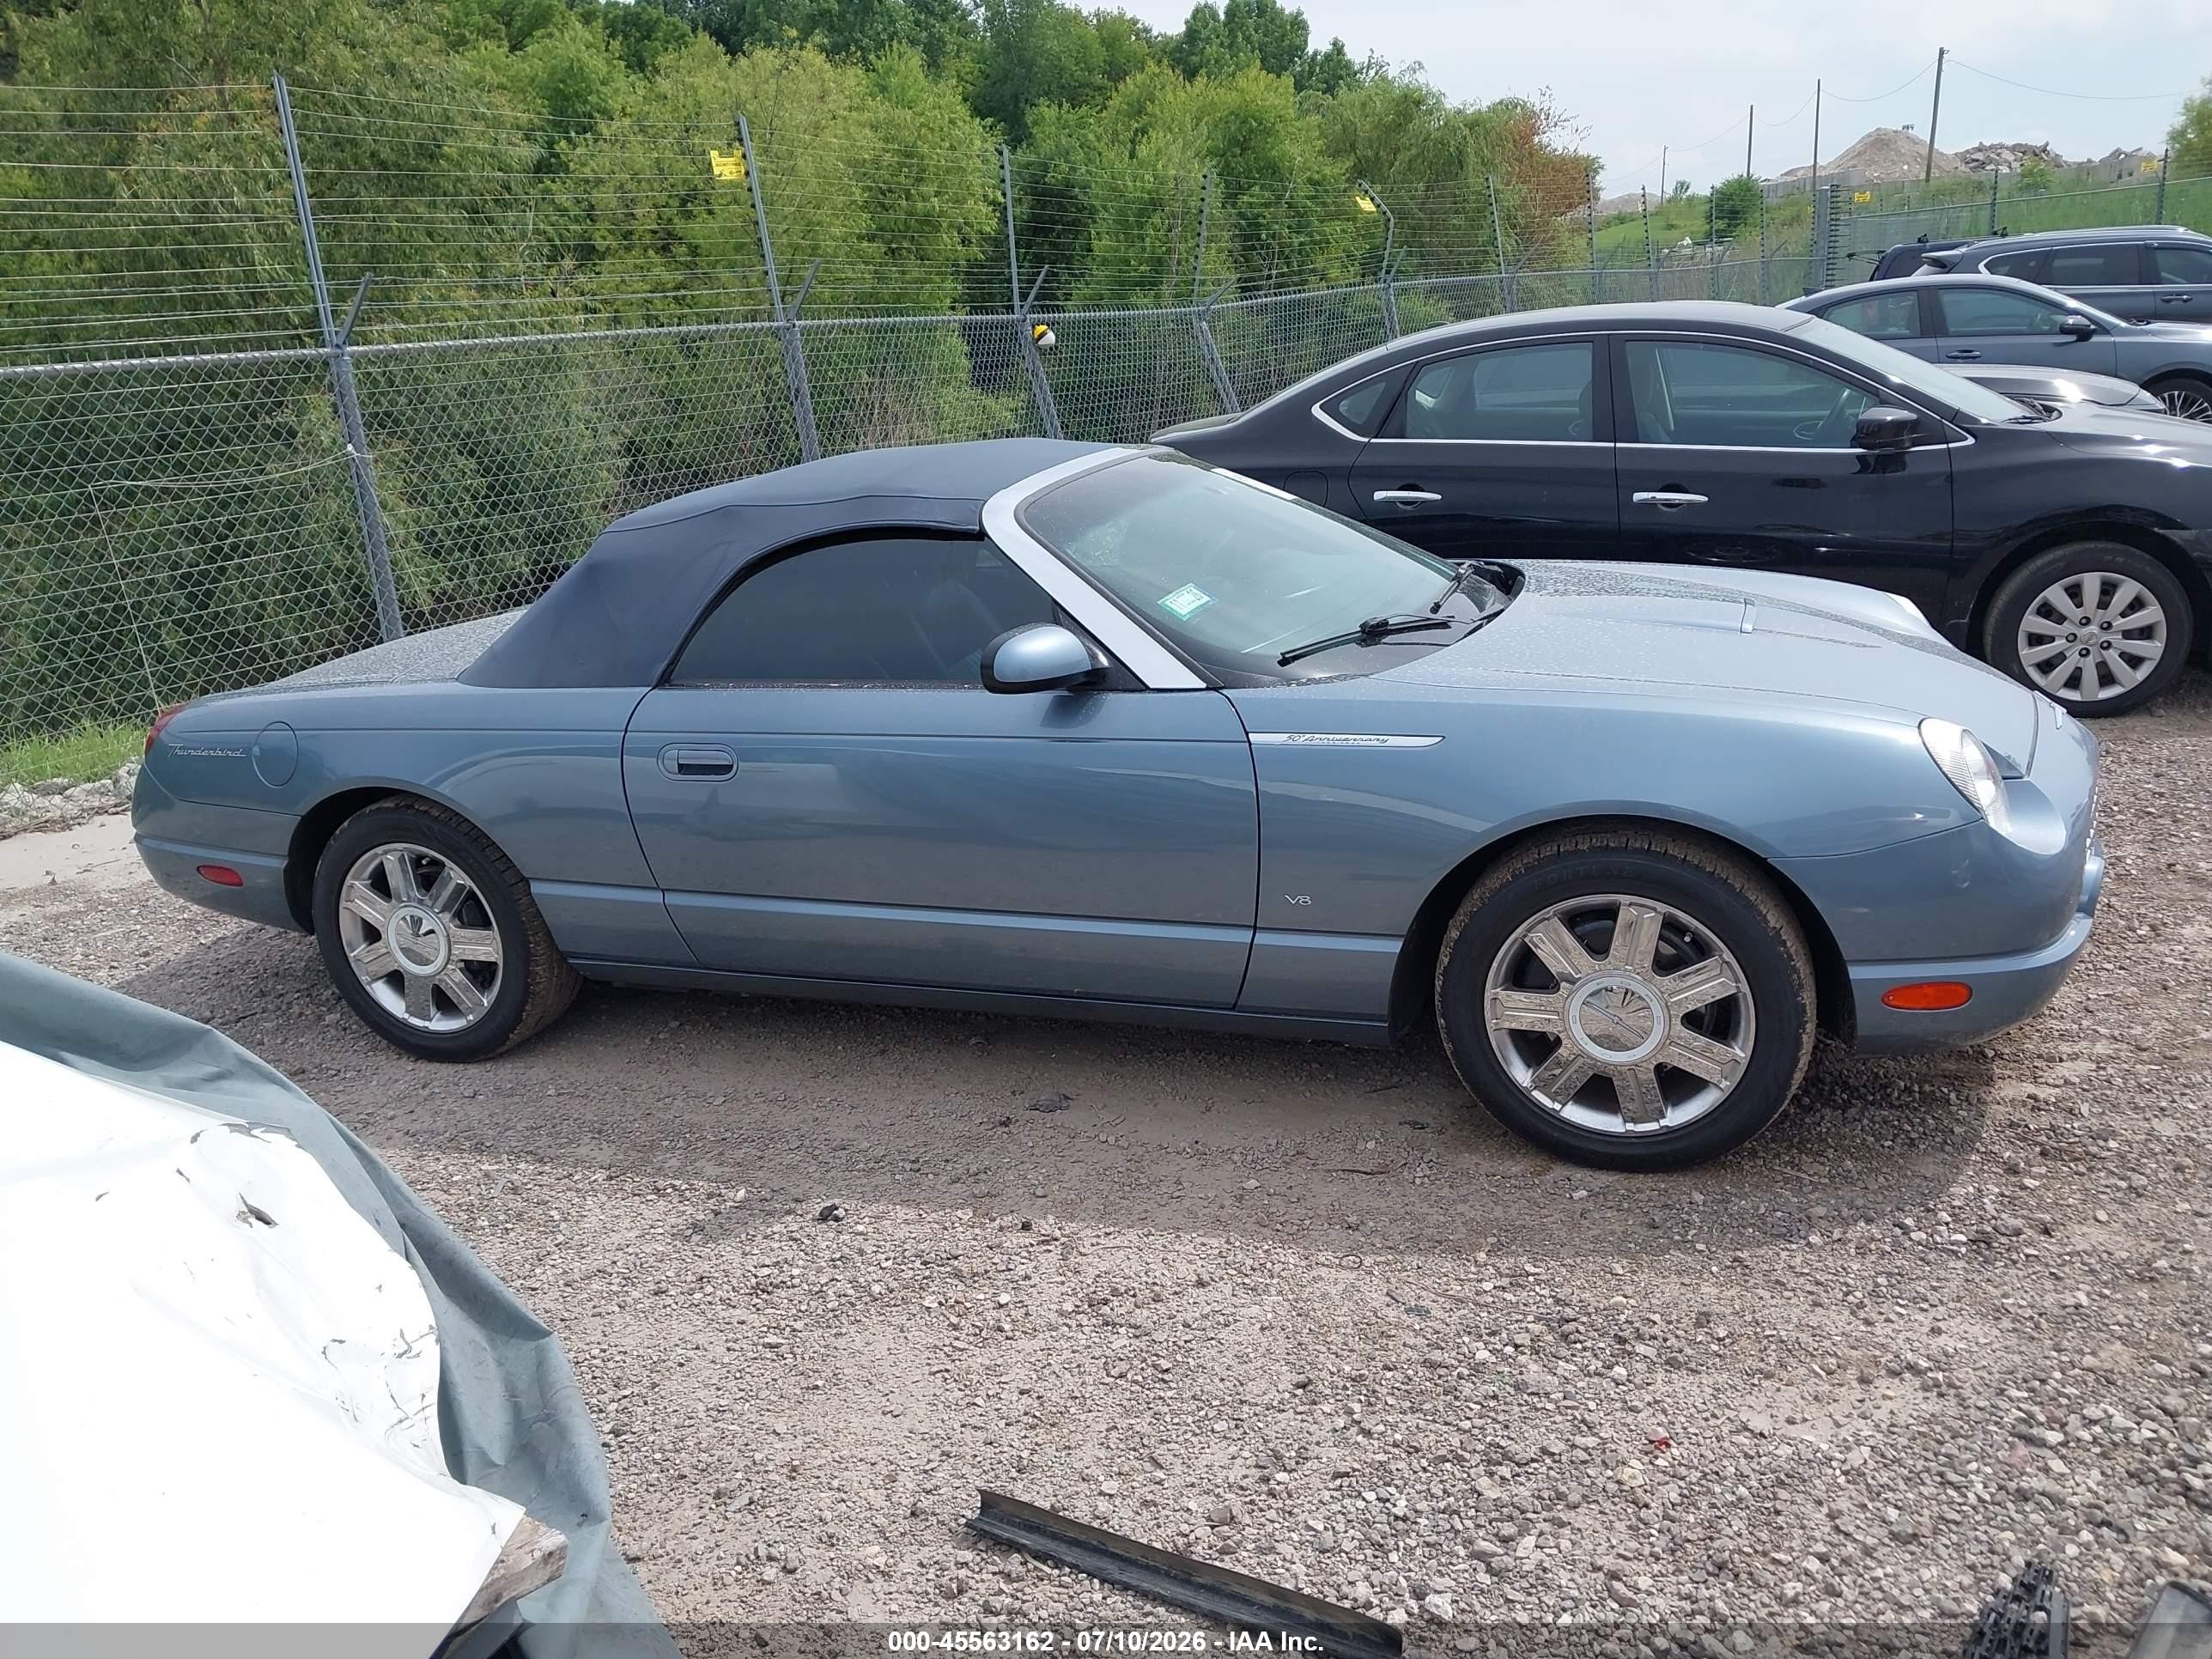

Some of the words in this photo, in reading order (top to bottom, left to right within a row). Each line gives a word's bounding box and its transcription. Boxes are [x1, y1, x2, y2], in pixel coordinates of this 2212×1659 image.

[1302, 735, 1389, 744] Anniversary
[167, 743, 247, 758] Thunderbird
[1284, 895, 1312, 906] V8
